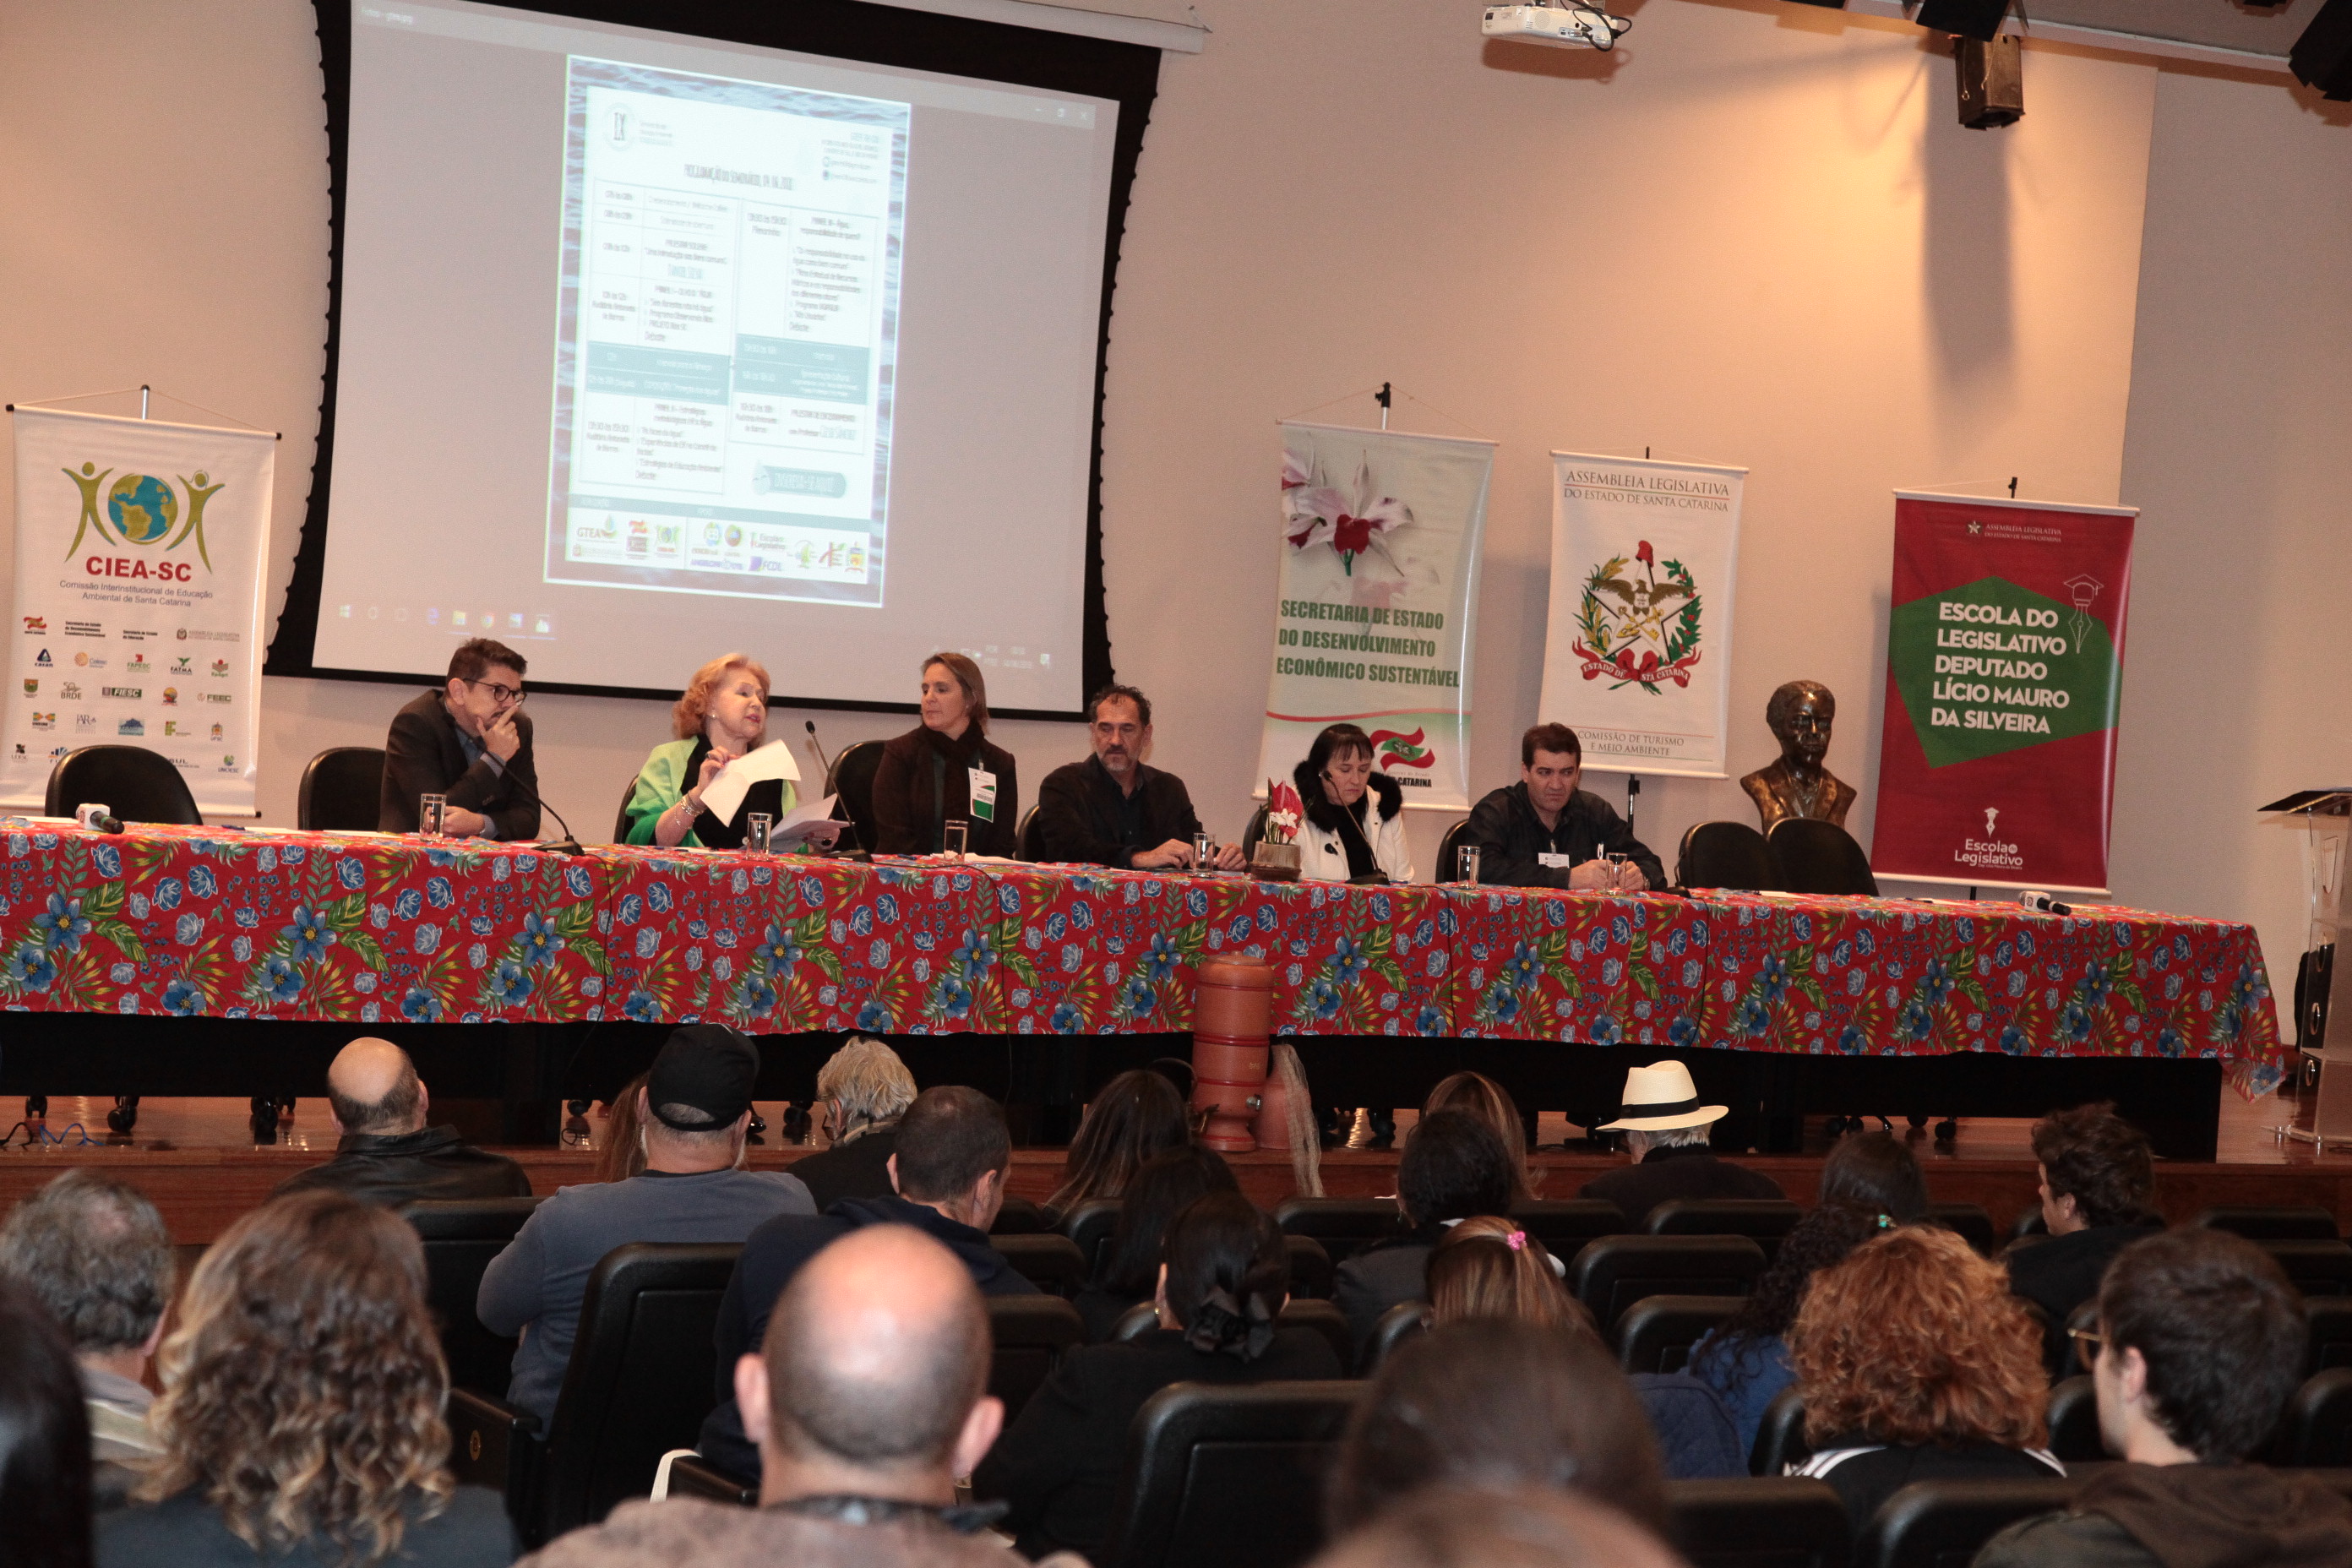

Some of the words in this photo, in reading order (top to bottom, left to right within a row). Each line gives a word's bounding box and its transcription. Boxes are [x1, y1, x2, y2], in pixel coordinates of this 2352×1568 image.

[1566, 471, 1645, 488] ASSEMBLEIA
[1650, 477, 1729, 496] LEGISLATIVA
[1564, 487, 1582, 498] DO
[1585, 490, 1624, 503] ESTADO
[1627, 493, 1641, 504] DE
[1643, 496, 1675, 507] SANTA
[1679, 498, 1729, 512] CATARINA
[86, 556, 192, 582] CIEA-SC
[59, 580, 99, 591] Comissão
[101, 583, 162, 595] Interinstitucional
[177, 588, 213, 600] Educação
[82, 591, 122, 602] Ambiental
[135, 595, 157, 605] Santa
[159, 596, 191, 607] Catarina
[1281, 600, 1369, 623] SECRETARIA
[1372, 607, 1391, 625] DE
[1394, 609, 1444, 629] ESTADO
[1940, 602, 2023, 626] ESCOLA
[2026, 608, 2058, 629] DO
[1278, 629, 1298, 646] DO
[1302, 630, 1435, 657] DESENVOLVIMENTO
[1937, 629, 2066, 656] LEGISLATIVO
[1277, 656, 1365, 680] ECONÔMICO
[1369, 664, 1459, 688] SUSTENTÁVEL
[1583, 663, 1614, 672] ESTADO
[1657, 668, 1689, 679] CATARINA
[1936, 655, 2048, 680] DEPUTADO
[1933, 677, 1990, 702] LÍCIO
[1993, 686, 2070, 709] MAURO
[1931, 707, 1960, 727] DA
[1963, 710, 2050, 734] SILVEIRA
[1578, 731, 1625, 743] COMISSÃO
[1644, 735, 1684, 746] TURISMO
[1598, 743, 1622, 752] MEIO
[1625, 745, 1669, 755] AMBIENTE
[1398, 777, 1432, 787] CATARINA
[1965, 838, 2008, 852] Escola
[1955, 849, 2023, 867] Legislativo
